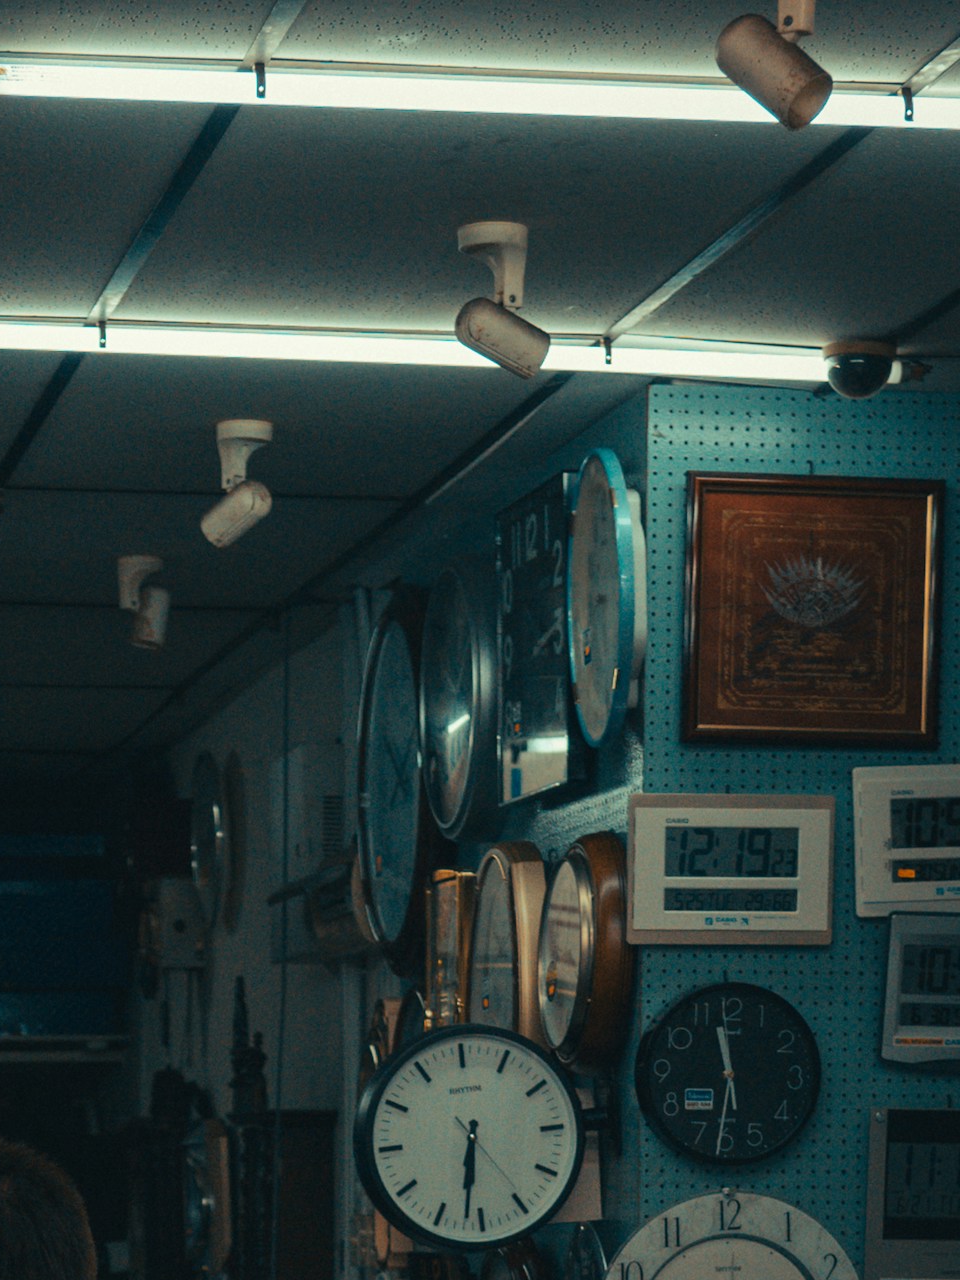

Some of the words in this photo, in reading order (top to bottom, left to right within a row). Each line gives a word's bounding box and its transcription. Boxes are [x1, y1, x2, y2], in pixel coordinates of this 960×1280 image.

[694, 1002, 709, 1026] 11
[667, 1026, 693, 1050] 10
[777, 1029, 795, 1053] 2
[653, 1058, 671, 1083] 9
[787, 1064, 804, 1090] 3
[663, 1091, 680, 1117] 8
[773, 1099, 790, 1122] 4
[691, 1120, 708, 1145] 7
[746, 1122, 764, 1147] 5
[719, 1199, 741, 1231] 12
[783, 1211, 792, 1242] 1
[663, 1217, 681, 1247] 11
